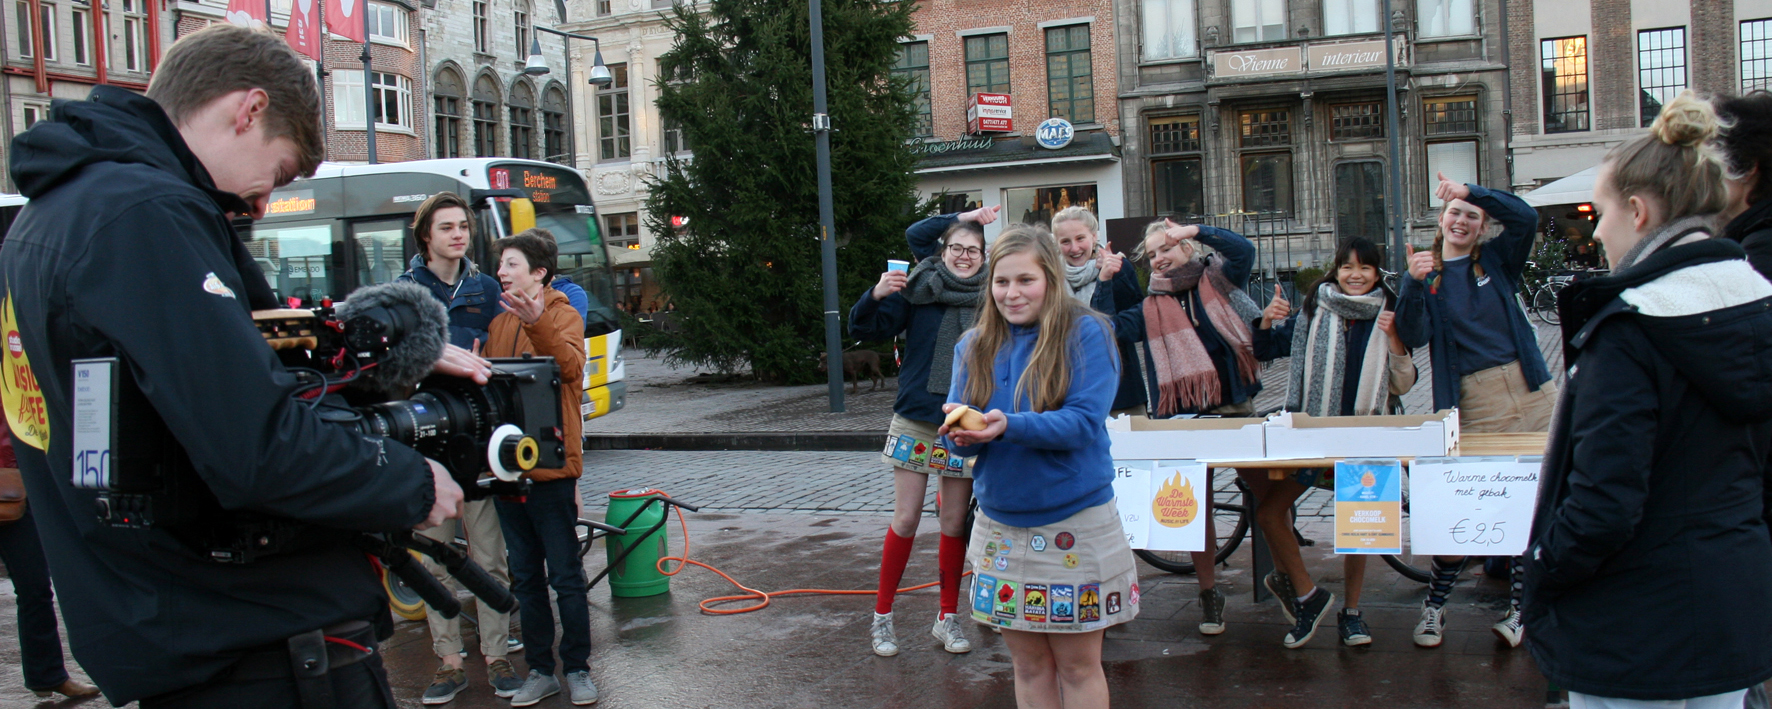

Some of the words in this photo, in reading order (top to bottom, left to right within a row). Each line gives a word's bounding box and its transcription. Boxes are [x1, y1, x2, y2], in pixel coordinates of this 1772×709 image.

[1228, 54, 1289, 72] Vienne
[1321, 50, 1383, 66] interieur
[1038, 126, 1072, 141] MAES
[523, 170, 557, 190] Berchem
[532, 190, 551, 203] station
[270, 197, 316, 214] station
[1443, 470, 1487, 483] Warme
[1489, 472, 1540, 482] chocomelk
[1169, 488, 1183, 498] De
[1454, 486, 1475, 497] met
[1477, 486, 1511, 501] gebak
[1156, 496, 1195, 507] Warmste
[1160, 507, 1189, 518] Week
[1353, 509, 1382, 517] VERKOOP
[1448, 517, 1507, 547] €2,5
